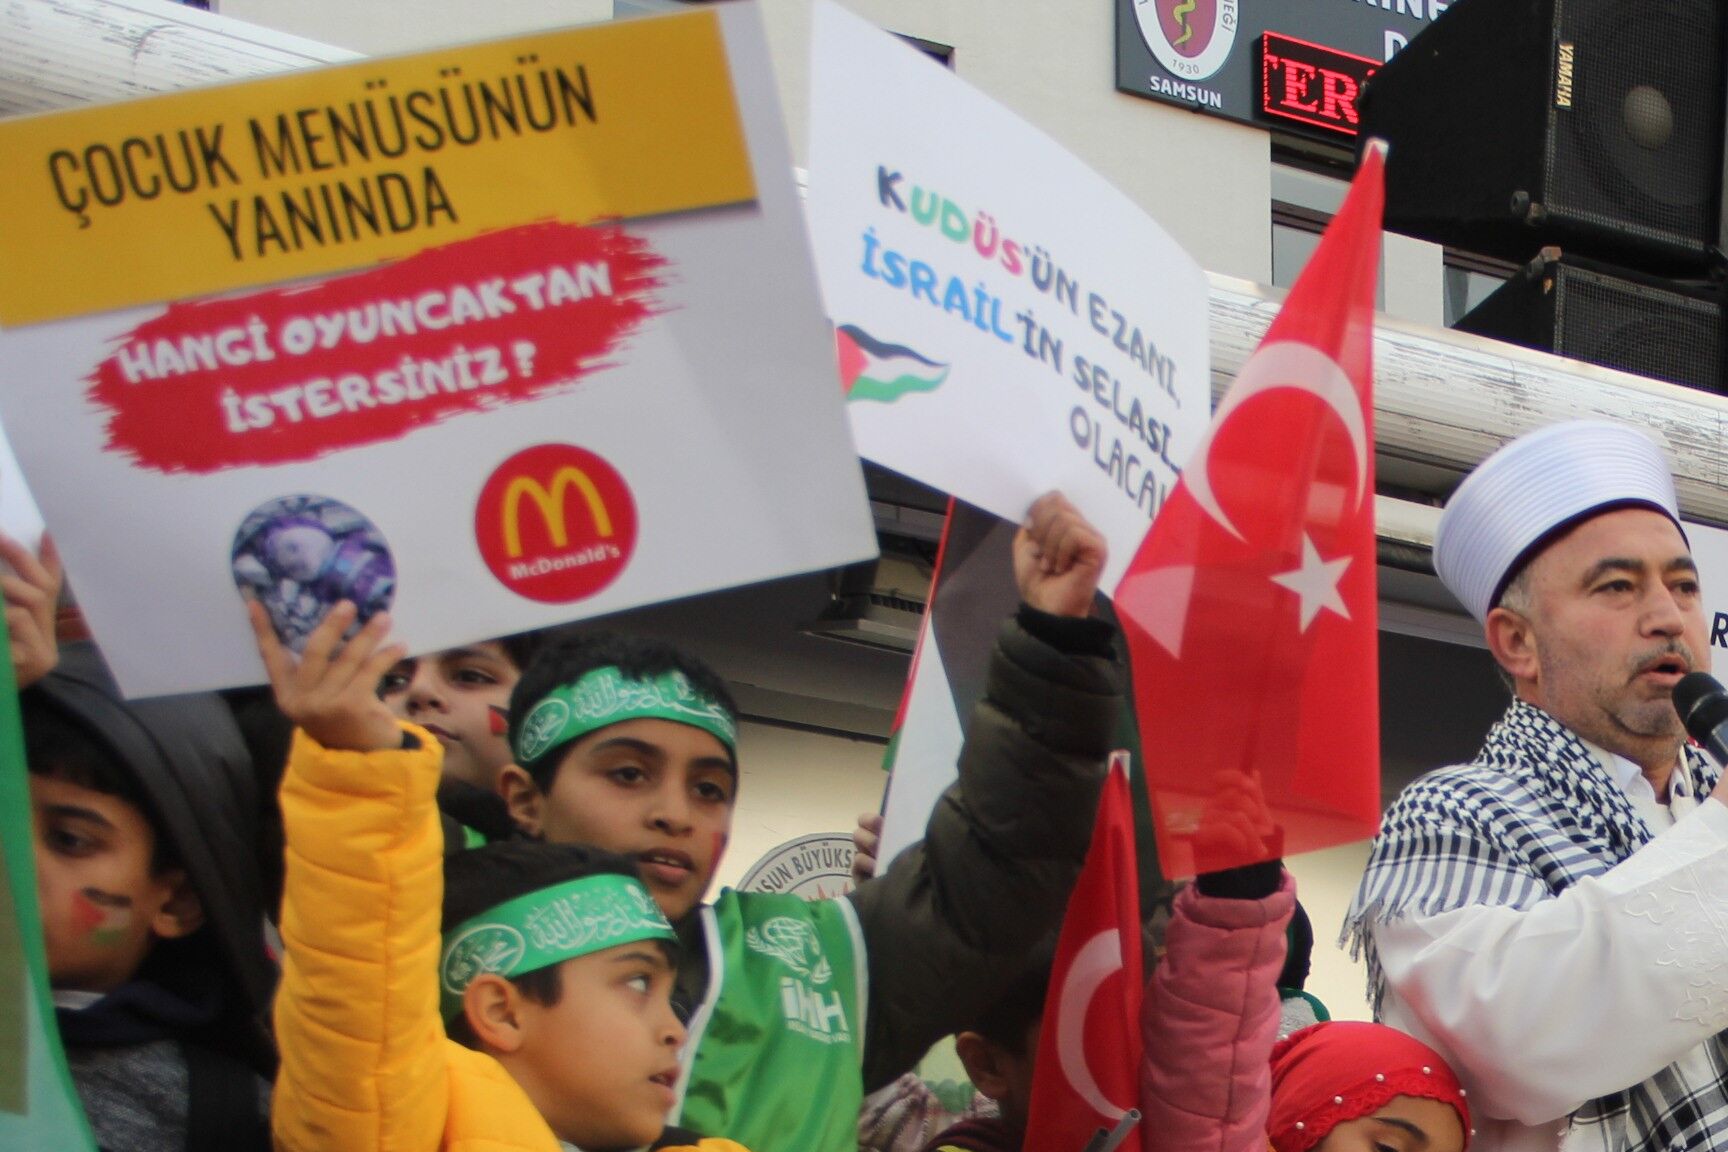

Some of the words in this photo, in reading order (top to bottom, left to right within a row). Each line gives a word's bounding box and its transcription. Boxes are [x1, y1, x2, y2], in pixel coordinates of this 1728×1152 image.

[1150, 75, 1222, 109] SAMSUN
[1172, 59, 1200, 75] 1930
[1557, 44, 1573, 106] YAMAHA
[47, 123, 240, 229] ÇOCUK
[248, 54, 598, 181] MENÜSÜNÜN
[208, 165, 459, 262] YANINDA
[117, 313, 275, 384] HANGİ
[281, 261, 613, 356] OYUNCAKTAN
[509, 545, 620, 580] McDonald's
